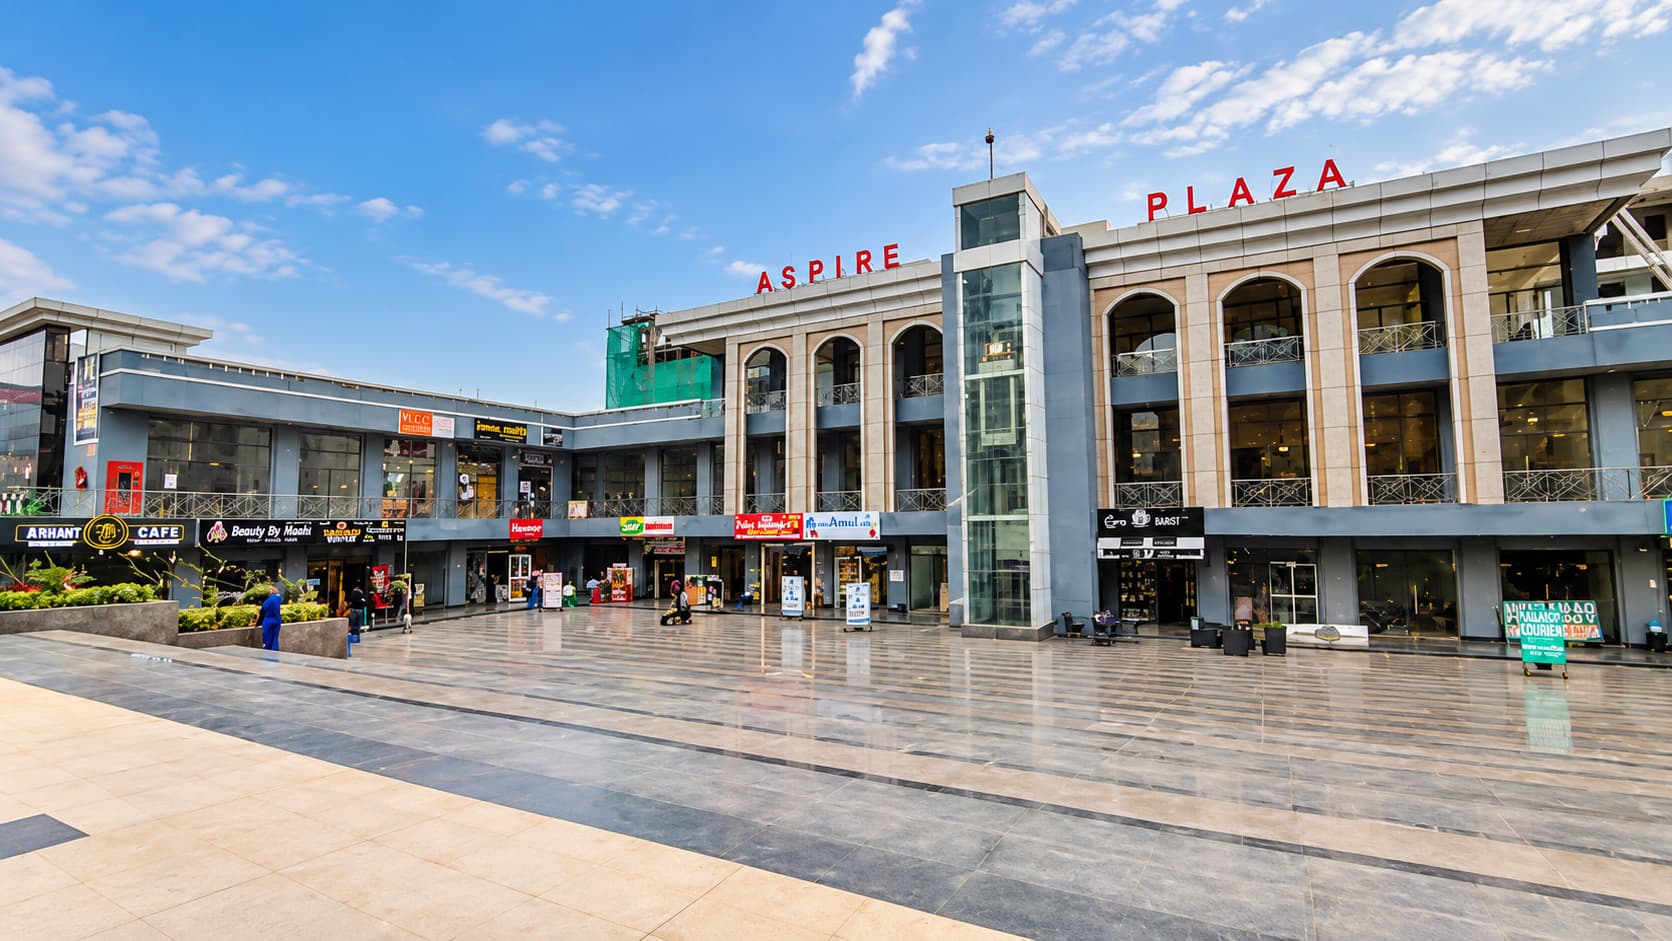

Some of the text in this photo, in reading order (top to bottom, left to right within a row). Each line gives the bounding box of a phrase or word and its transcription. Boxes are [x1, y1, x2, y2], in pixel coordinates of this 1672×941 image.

[757, 159, 1348, 295] ASPIRE PLAZA
[402, 411, 430, 425] VLCC
[829, 516, 858, 527] Amul
[26, 526, 179, 540] ARHANT CAFE
[231, 525, 266, 539] Beauty
[267, 525, 281, 538] By
